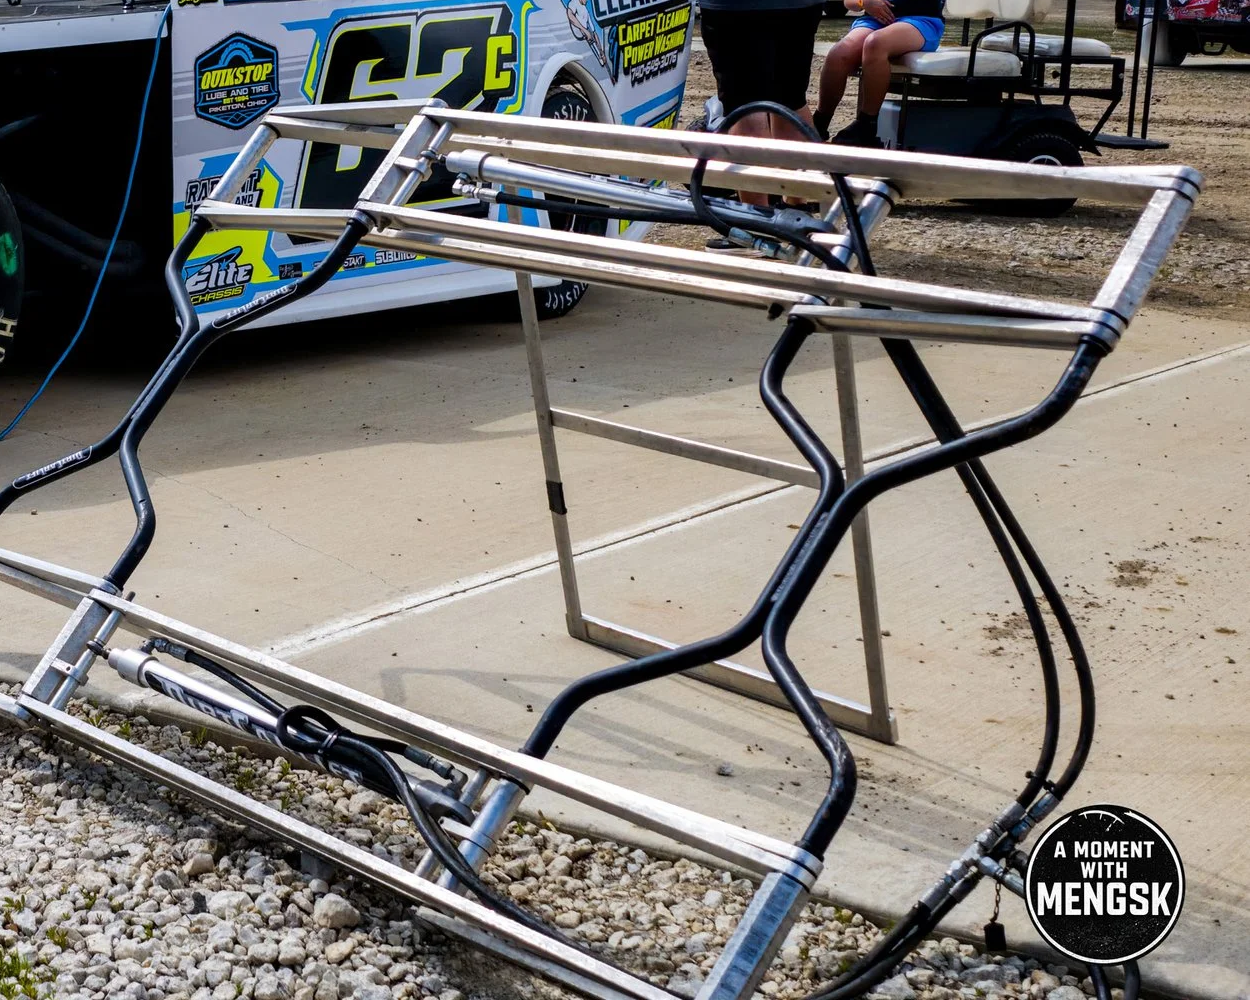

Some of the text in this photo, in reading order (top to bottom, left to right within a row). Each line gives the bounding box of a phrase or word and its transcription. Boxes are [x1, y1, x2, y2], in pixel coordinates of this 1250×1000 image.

[618, 5, 691, 46] CARPET CLEANING
[623, 38, 655, 67] POWER
[201, 62, 273, 90] QUIKSTOP
[205, 83, 269, 101] LUBE AND TIRE
[208, 98, 268, 114] PIKETON, OHIO
[186, 262, 252, 291] Elite
[191, 286, 244, 304] CHASSIS
